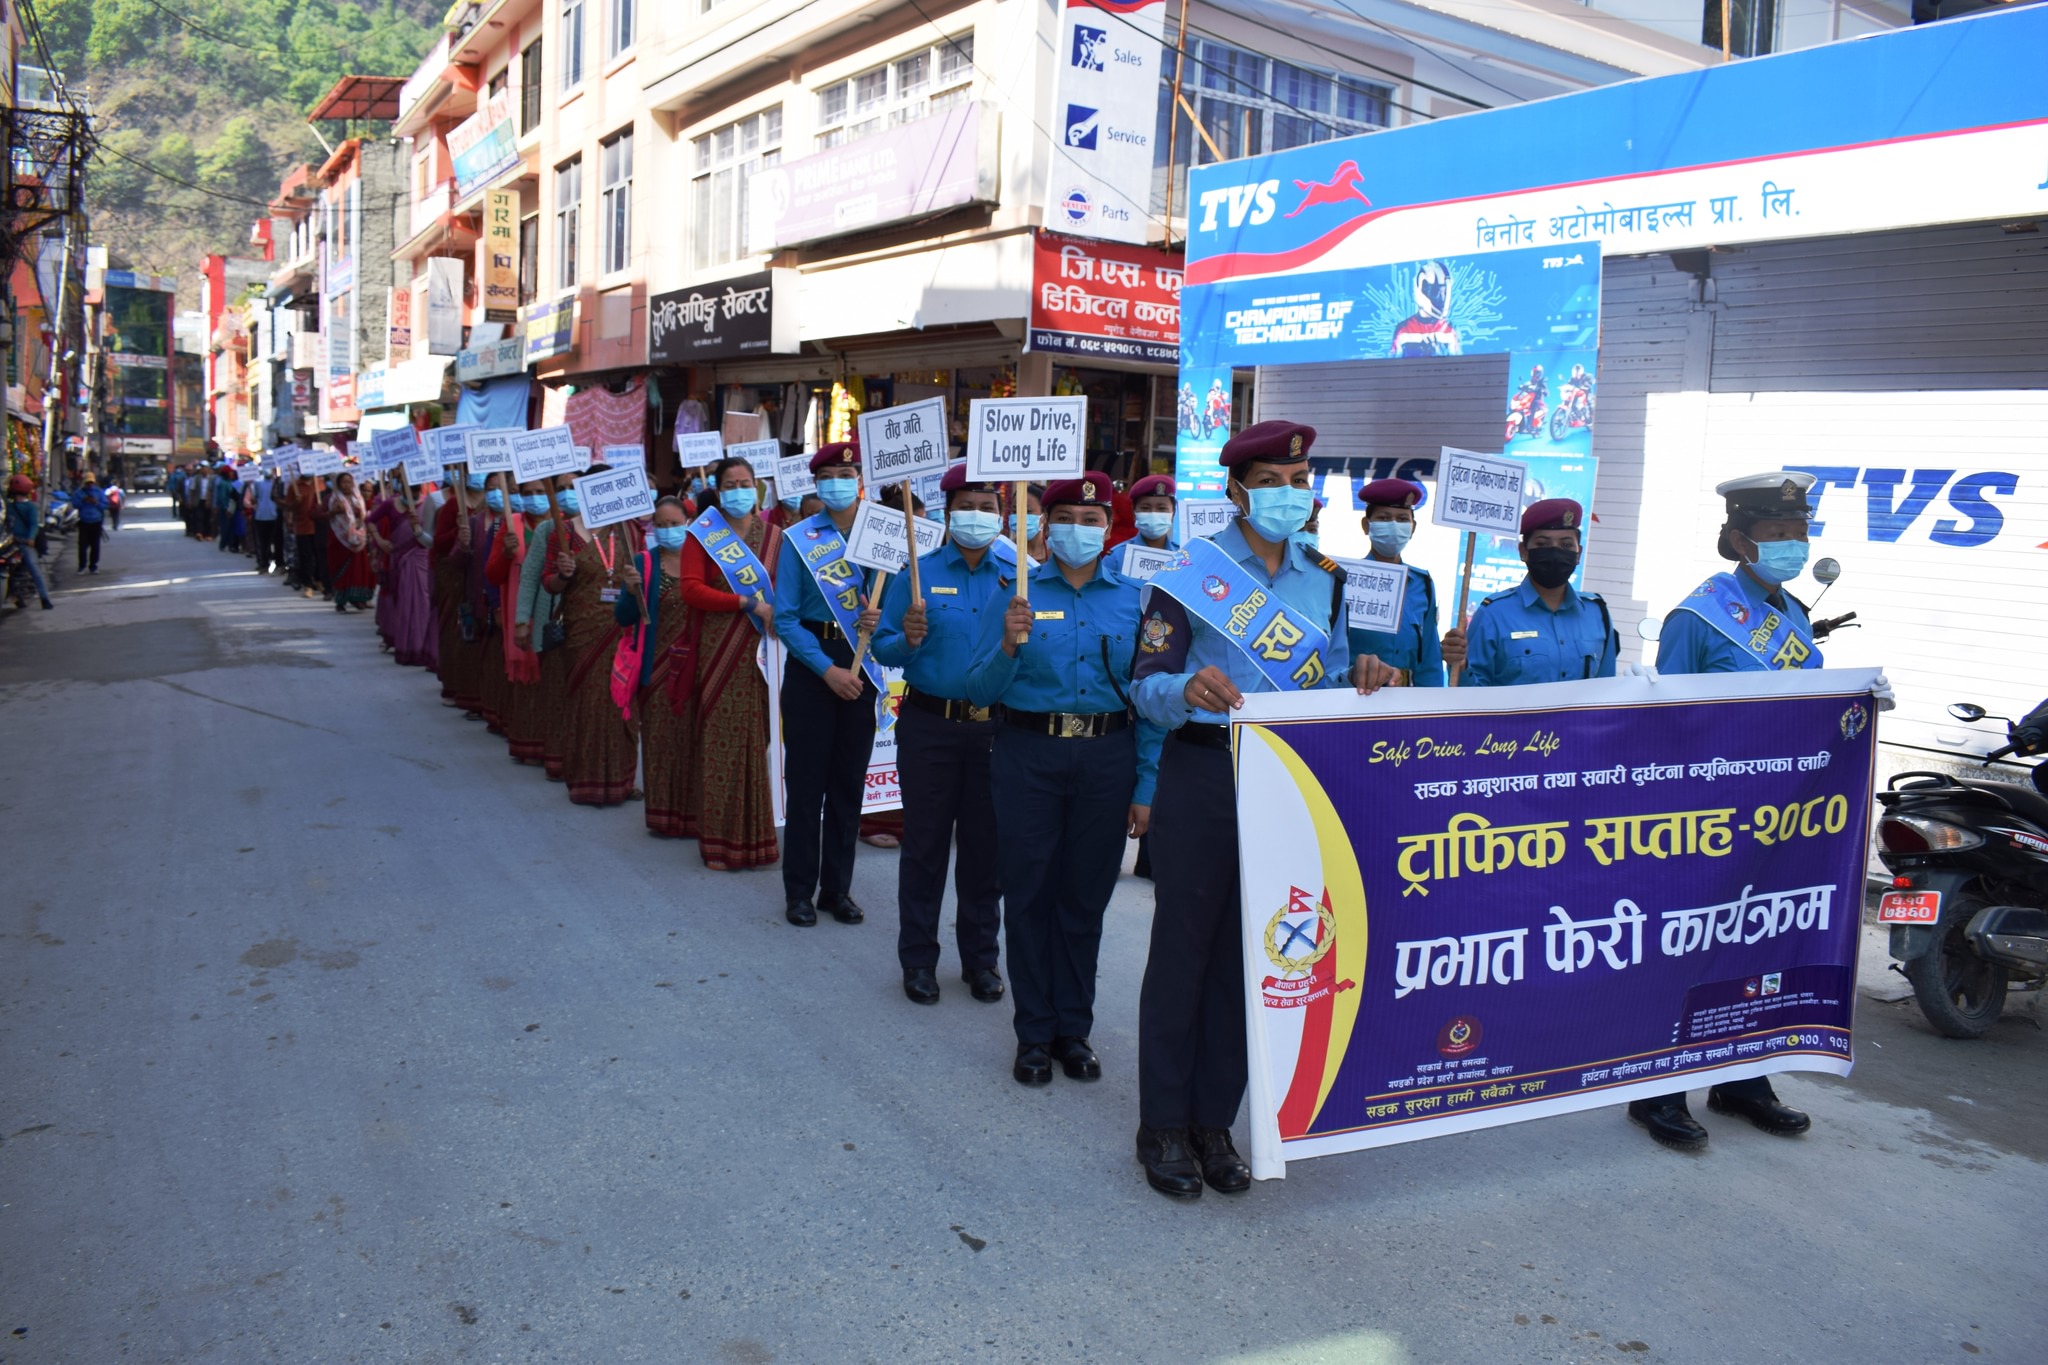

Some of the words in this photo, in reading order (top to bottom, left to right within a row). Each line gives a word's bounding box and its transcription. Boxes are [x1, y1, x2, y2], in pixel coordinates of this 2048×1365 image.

[1114, 48, 1142, 66] Sales
[1107, 126, 1147, 146] Service
[1102, 204, 1129, 222] Parts
[1199, 179, 1280, 232] TVS
[1476, 213, 1536, 248] बिनोद
[1548, 201, 1696, 241] अटोमोबाइल्स
[1709, 195, 1742, 224] प्रा.
[1761, 181, 1801, 219] लि.
[1155, 266, 1184, 300] फु
[722, 287, 770, 320] सेन्टर
[1041, 282, 1129, 320] डिजिटल
[1225, 302, 1323, 327] CHAMPIONS
[1326, 300, 1354, 319] OF
[1037, 333, 1062, 347] फोन
[1233, 321, 1343, 345] TECHNOLOGY
[986, 408, 1026, 432] Slow
[1030, 407, 1077, 436] Drive,
[539, 435, 557, 450] brings
[874, 444, 911, 471] जीवनको
[913, 439, 934, 464] क्षति
[992, 438, 1031, 468] Long
[1037, 437, 1068, 462] Life
[521, 457, 538, 473] safety
[538, 455, 555, 471] brings
[616, 472, 638, 491] सवारी
[625, 490, 648, 508] तयारी
[1782, 465, 2020, 547] TVS
[1208, 507, 1225, 524] पायो
[1225, 587, 1268, 640] ट्राफिक
[1368, 740, 1412, 768] Safe
[1475, 733, 1518, 759] Long
[1523, 730, 1560, 758] Life
[1414, 780, 1458, 800] सडक
[1462, 774, 1539, 798] अनुशासन
[1543, 771, 1577, 789] तथा
[1581, 764, 1627, 788] सवारी
[1631, 762, 1684, 787] दुर्घटना
[1688, 755, 1793, 782] न्यूनिकरणका
[1797, 750, 1832, 773] लागि
[1397, 812, 1569, 898] ट्राफिक
[1884, 906, 1932, 920] ७४६०
[1394, 927, 1529, 999] प्रभात
[1543, 898, 1648, 974] फेरी
[1660, 884, 1837, 958] कार्यक्रम
[1274, 979, 1295, 989] नेपाल
[1655, 1056, 1671, 1069] तथा
[1673, 1051, 1703, 1071] ट्राफिक
[1737, 1039, 1764, 1055] समस्या
[1366, 1102, 1399, 1119] सडक
[1404, 1094, 1441, 1116] सुरक्षा
[1447, 1087, 1475, 1105] हामी
[1480, 1083, 1515, 1099] सबैको
[1521, 1079, 1547, 1094] रक्षा
